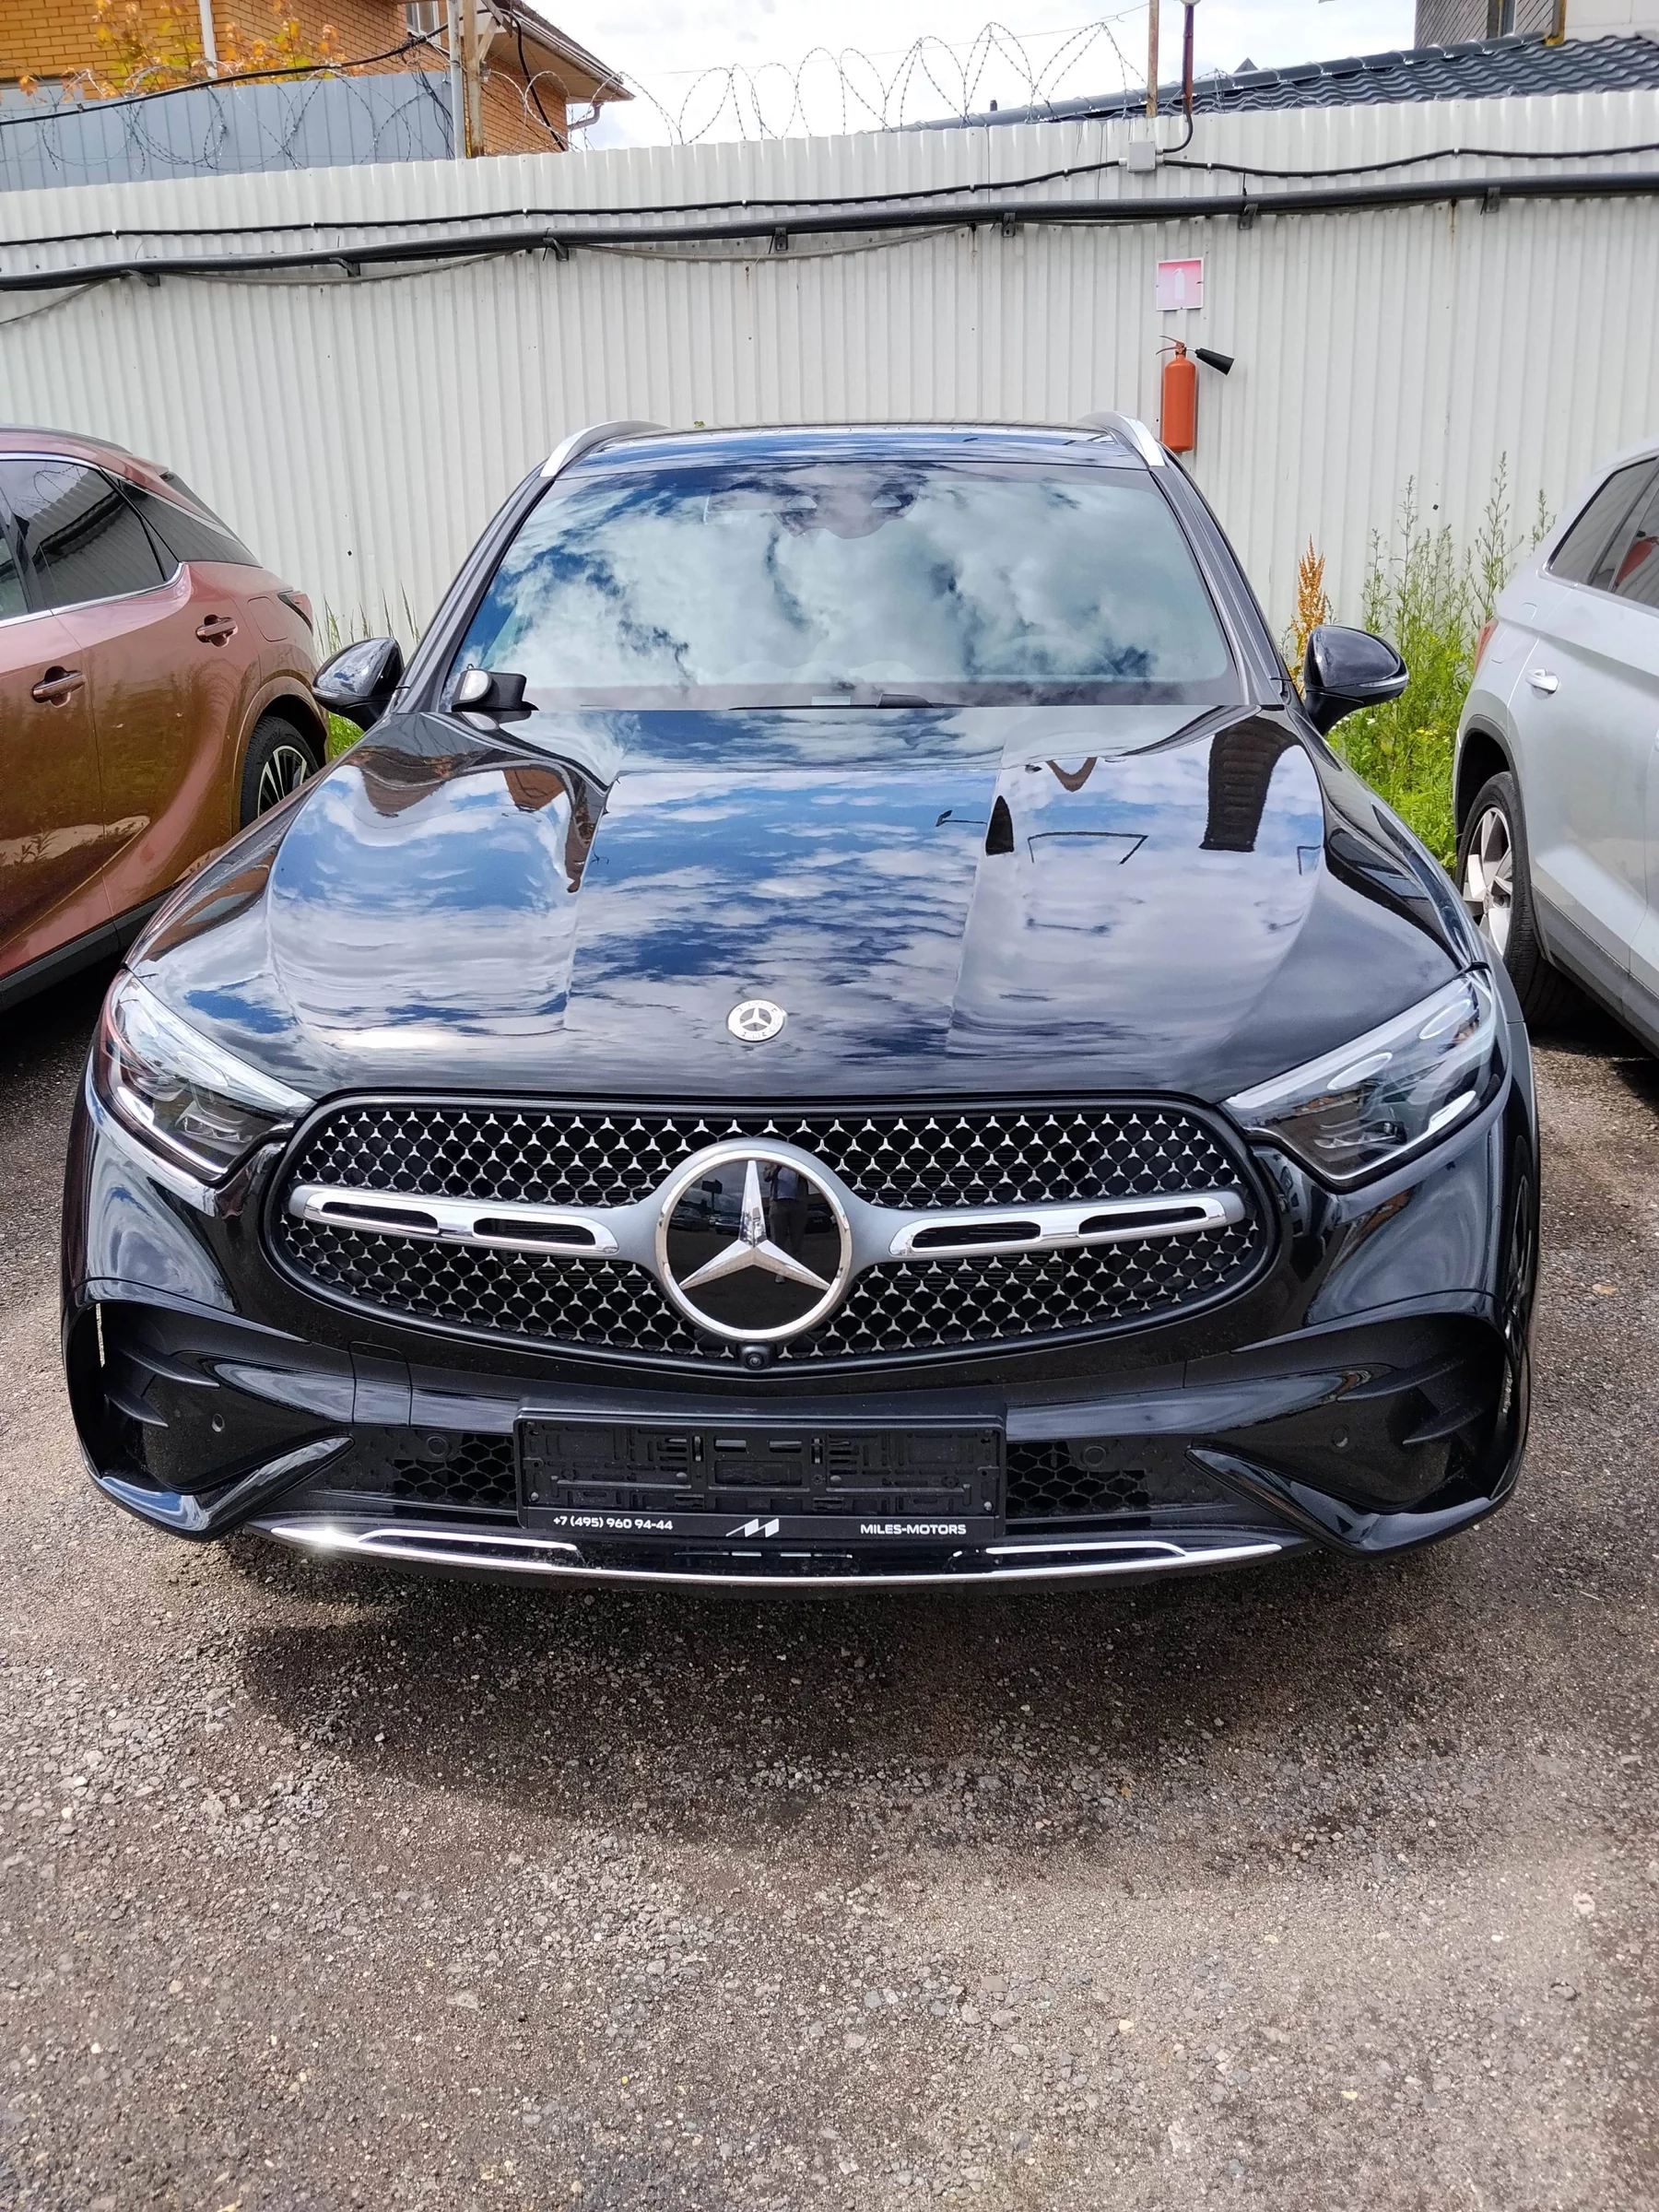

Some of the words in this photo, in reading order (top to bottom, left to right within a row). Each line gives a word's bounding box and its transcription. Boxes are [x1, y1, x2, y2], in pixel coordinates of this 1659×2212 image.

[553, 1515, 568, 1526] +7
[570, 1514, 605, 1528] (495)
[606, 1517, 632, 1529] 960
[634, 1518, 674, 1531] 94-44
[860, 1524, 967, 1535] MILES-MOTORS
